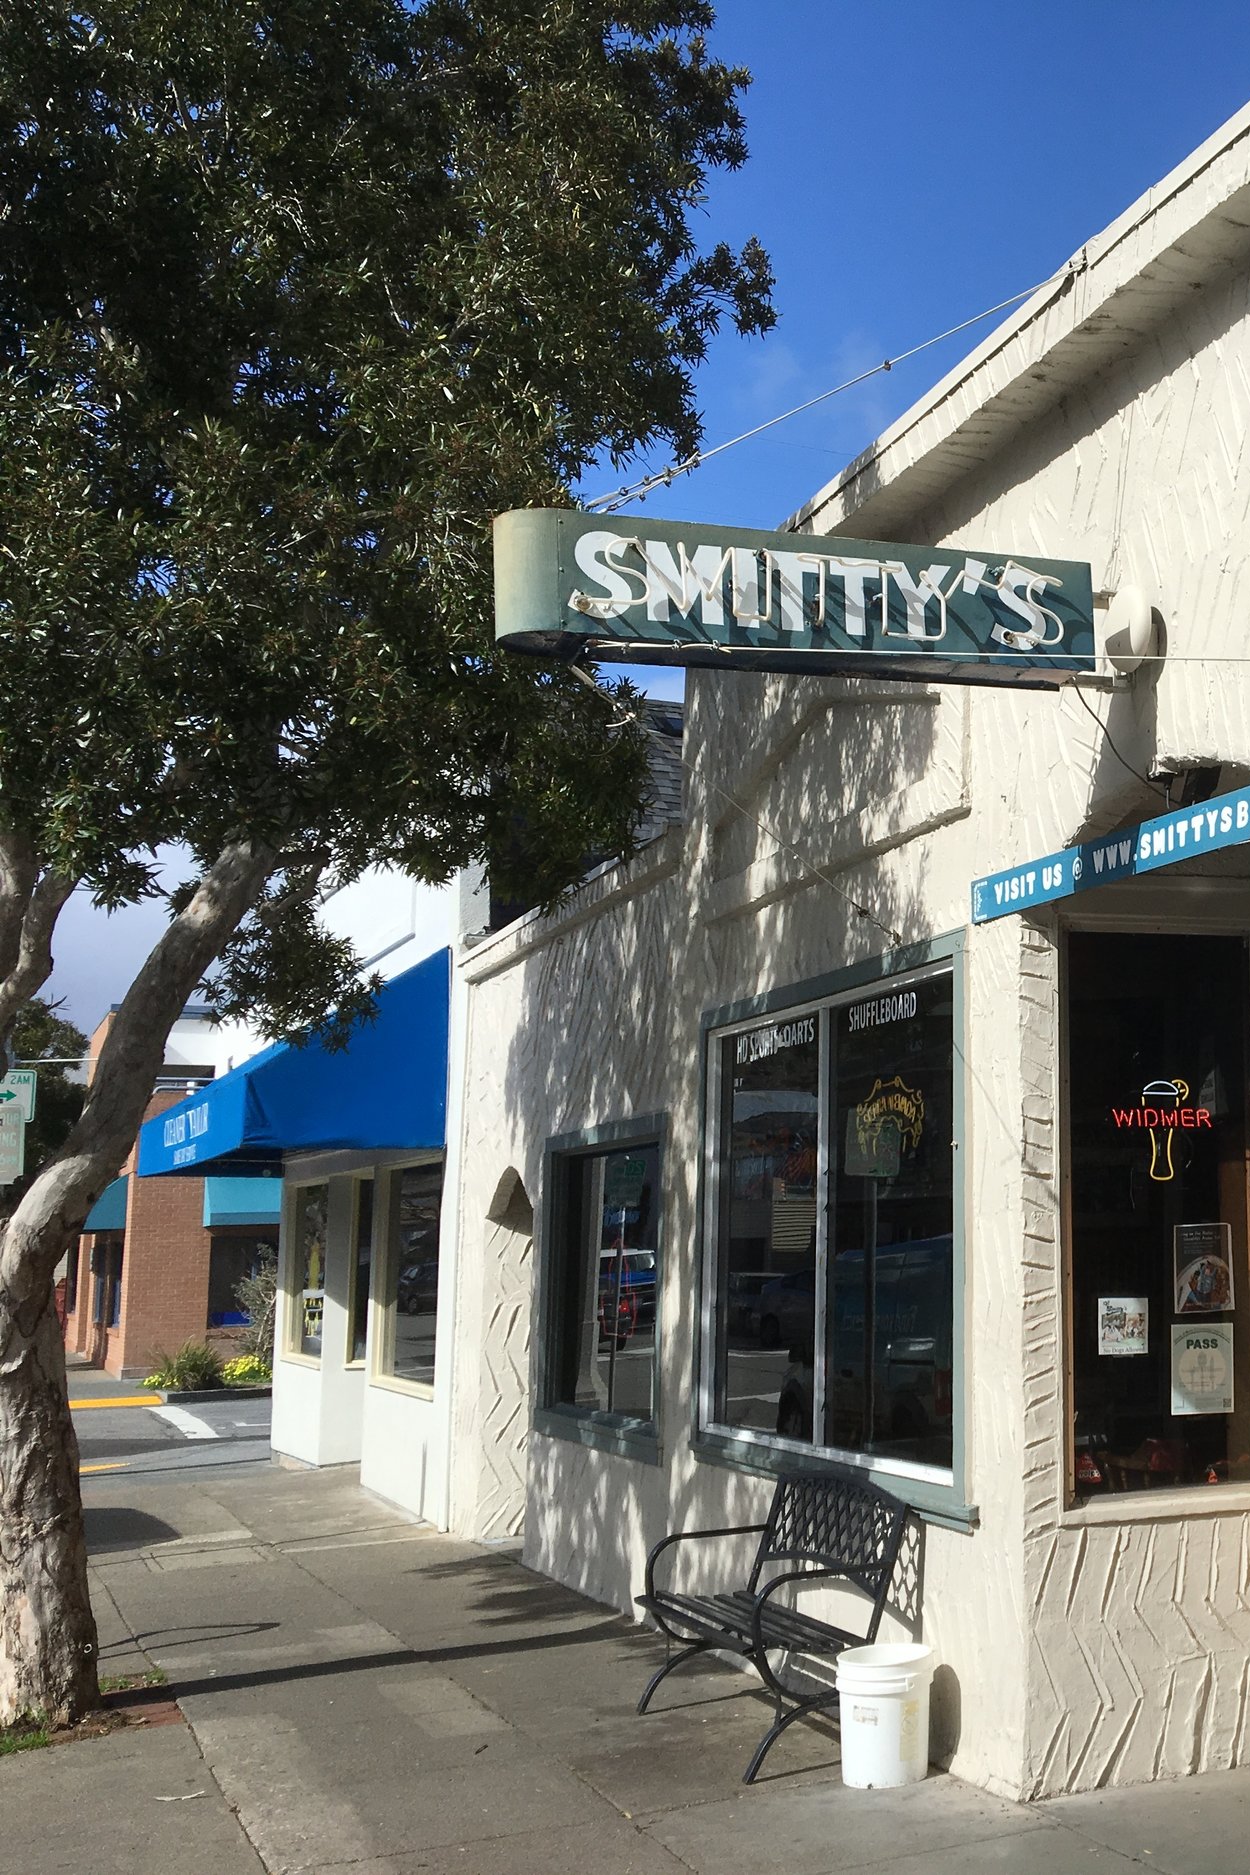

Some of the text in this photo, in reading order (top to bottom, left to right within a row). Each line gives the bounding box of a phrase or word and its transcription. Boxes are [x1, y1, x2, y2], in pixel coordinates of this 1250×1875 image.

[568, 531, 1064, 651] SMITTY'S
[993, 871, 1035, 906] VISIT
[1042, 862, 1063, 890] US
[1072, 855, 1084, 881] @
[848, 991, 917, 1032] SHUFFLEBOARD
[736, 1035, 748, 1065] HD
[10, 1075, 31, 1085] 2AM
[1111, 1108, 1212, 1129] WIDMER
[1186, 1338, 1219, 1350] PASS
